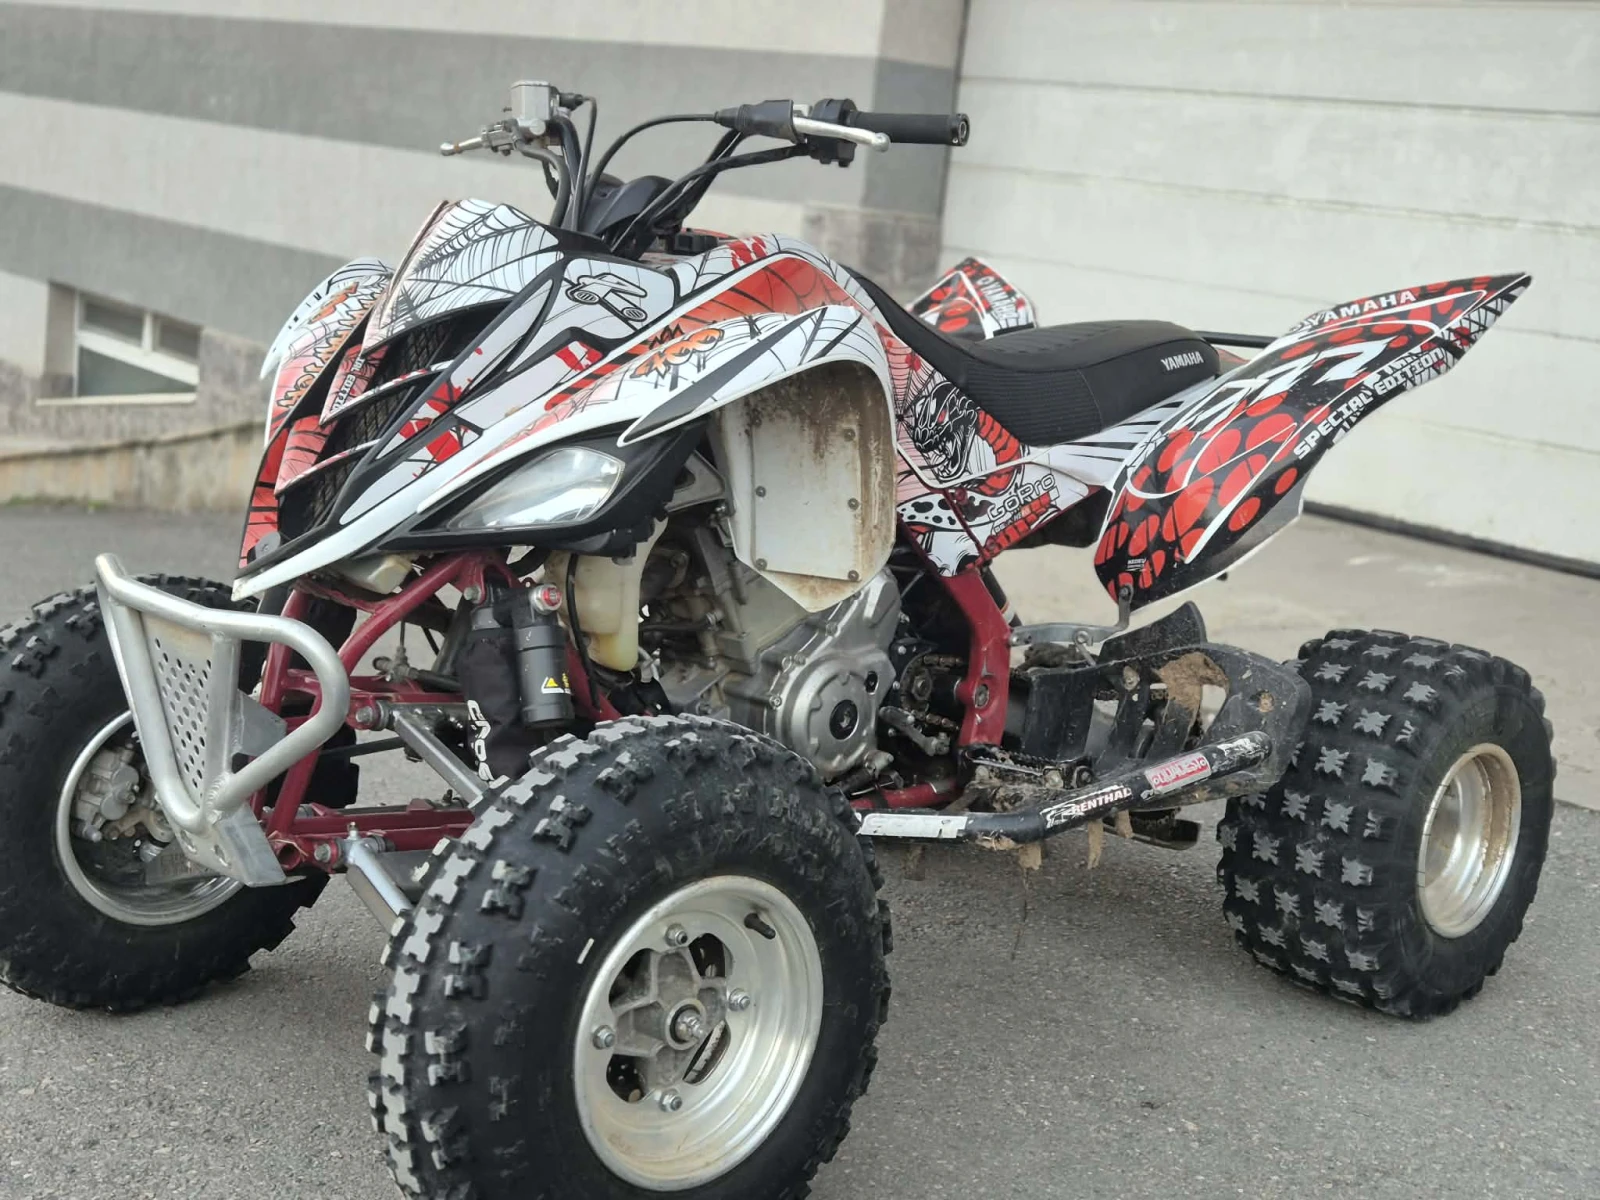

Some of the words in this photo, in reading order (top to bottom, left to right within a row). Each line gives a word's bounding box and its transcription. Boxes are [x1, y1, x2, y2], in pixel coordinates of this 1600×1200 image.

[1307, 290, 1417, 327] YAMAHA
[1160, 351, 1204, 371] YAMAHA
[1293, 390, 1374, 459] SPECIAL
[1374, 347, 1444, 396] EDITION
